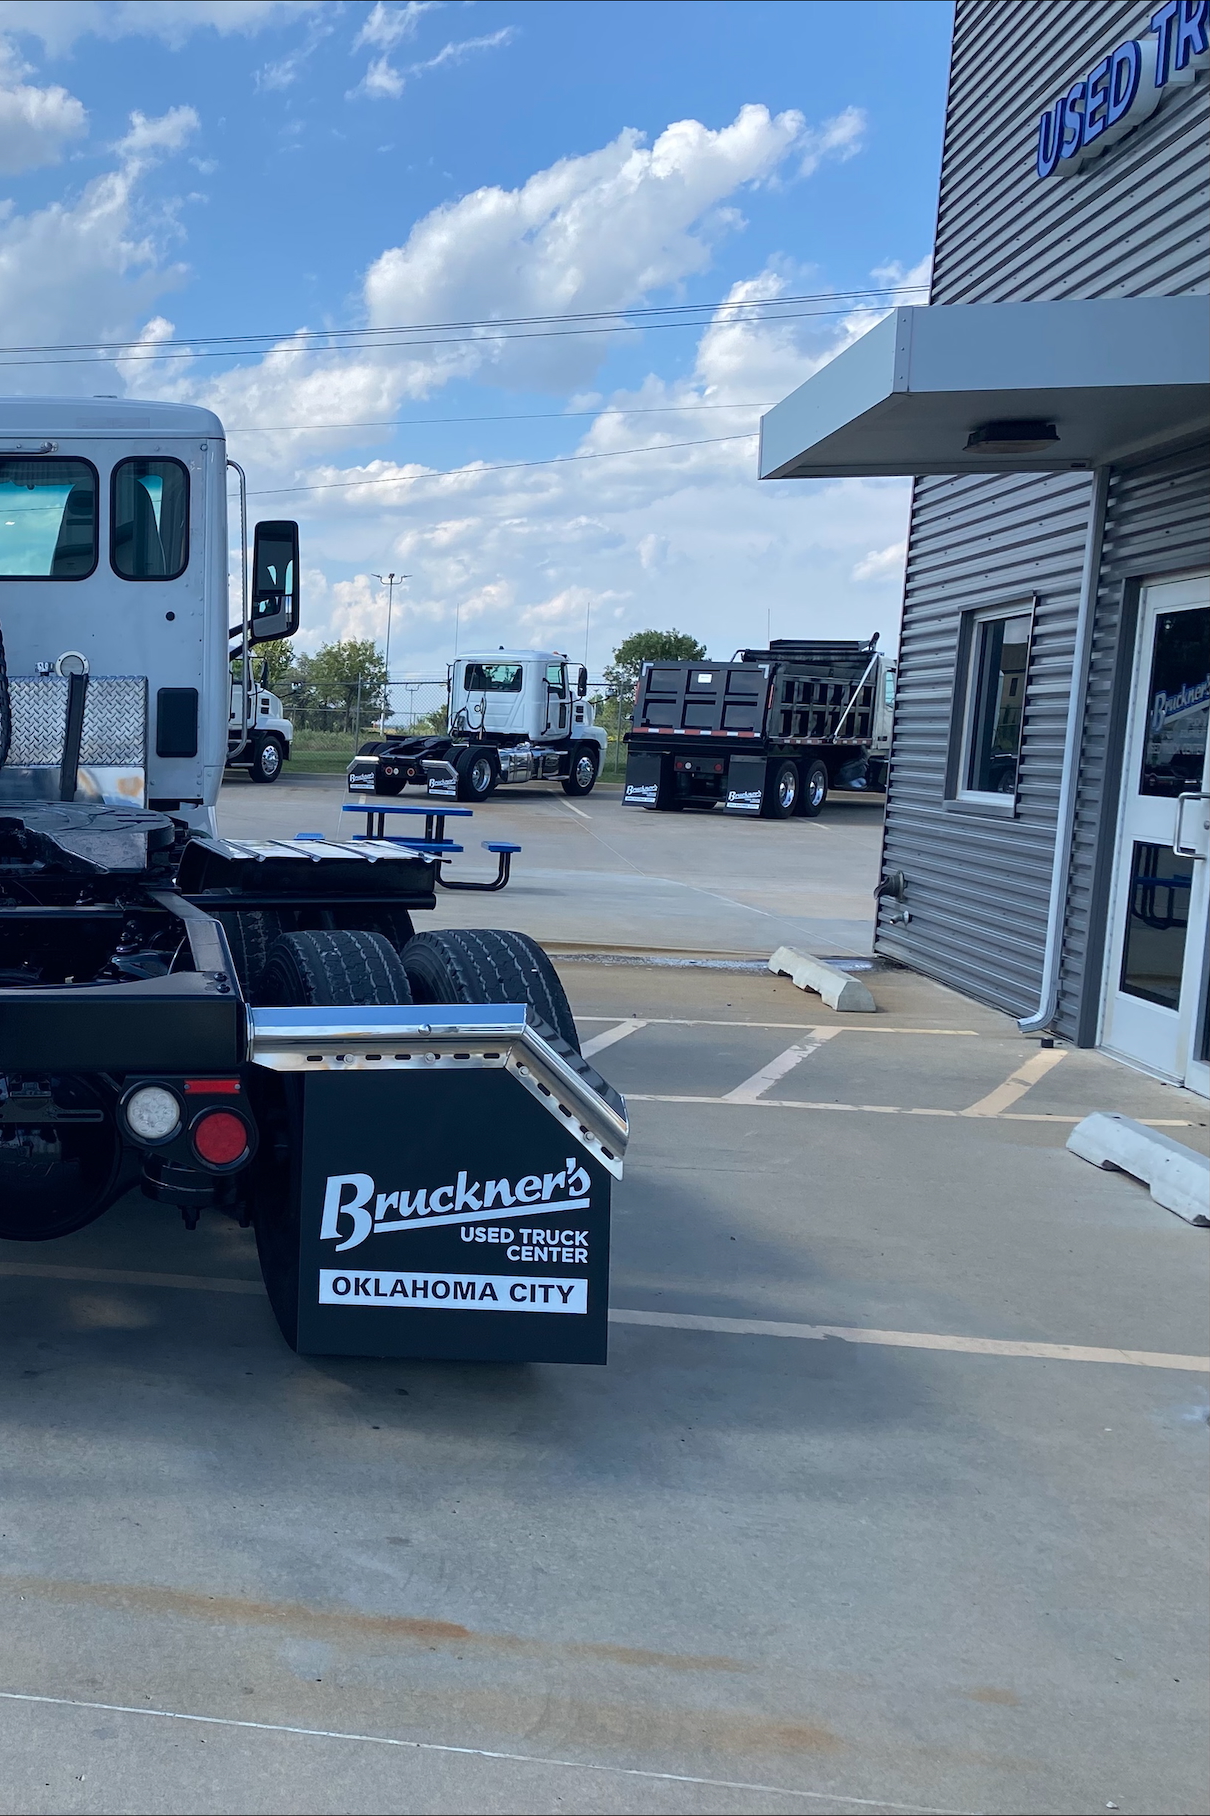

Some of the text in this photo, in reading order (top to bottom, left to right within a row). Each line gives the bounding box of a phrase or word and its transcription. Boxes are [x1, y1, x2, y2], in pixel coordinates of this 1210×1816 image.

[1037, 0, 1210, 178] USED TR
[320, 1157, 591, 1252] Bruckner's
[460, 1226, 589, 1246] USED TRUCK
[506, 1246, 588, 1264] CENTER
[332, 1276, 575, 1304] OKLAHOMA CITY
